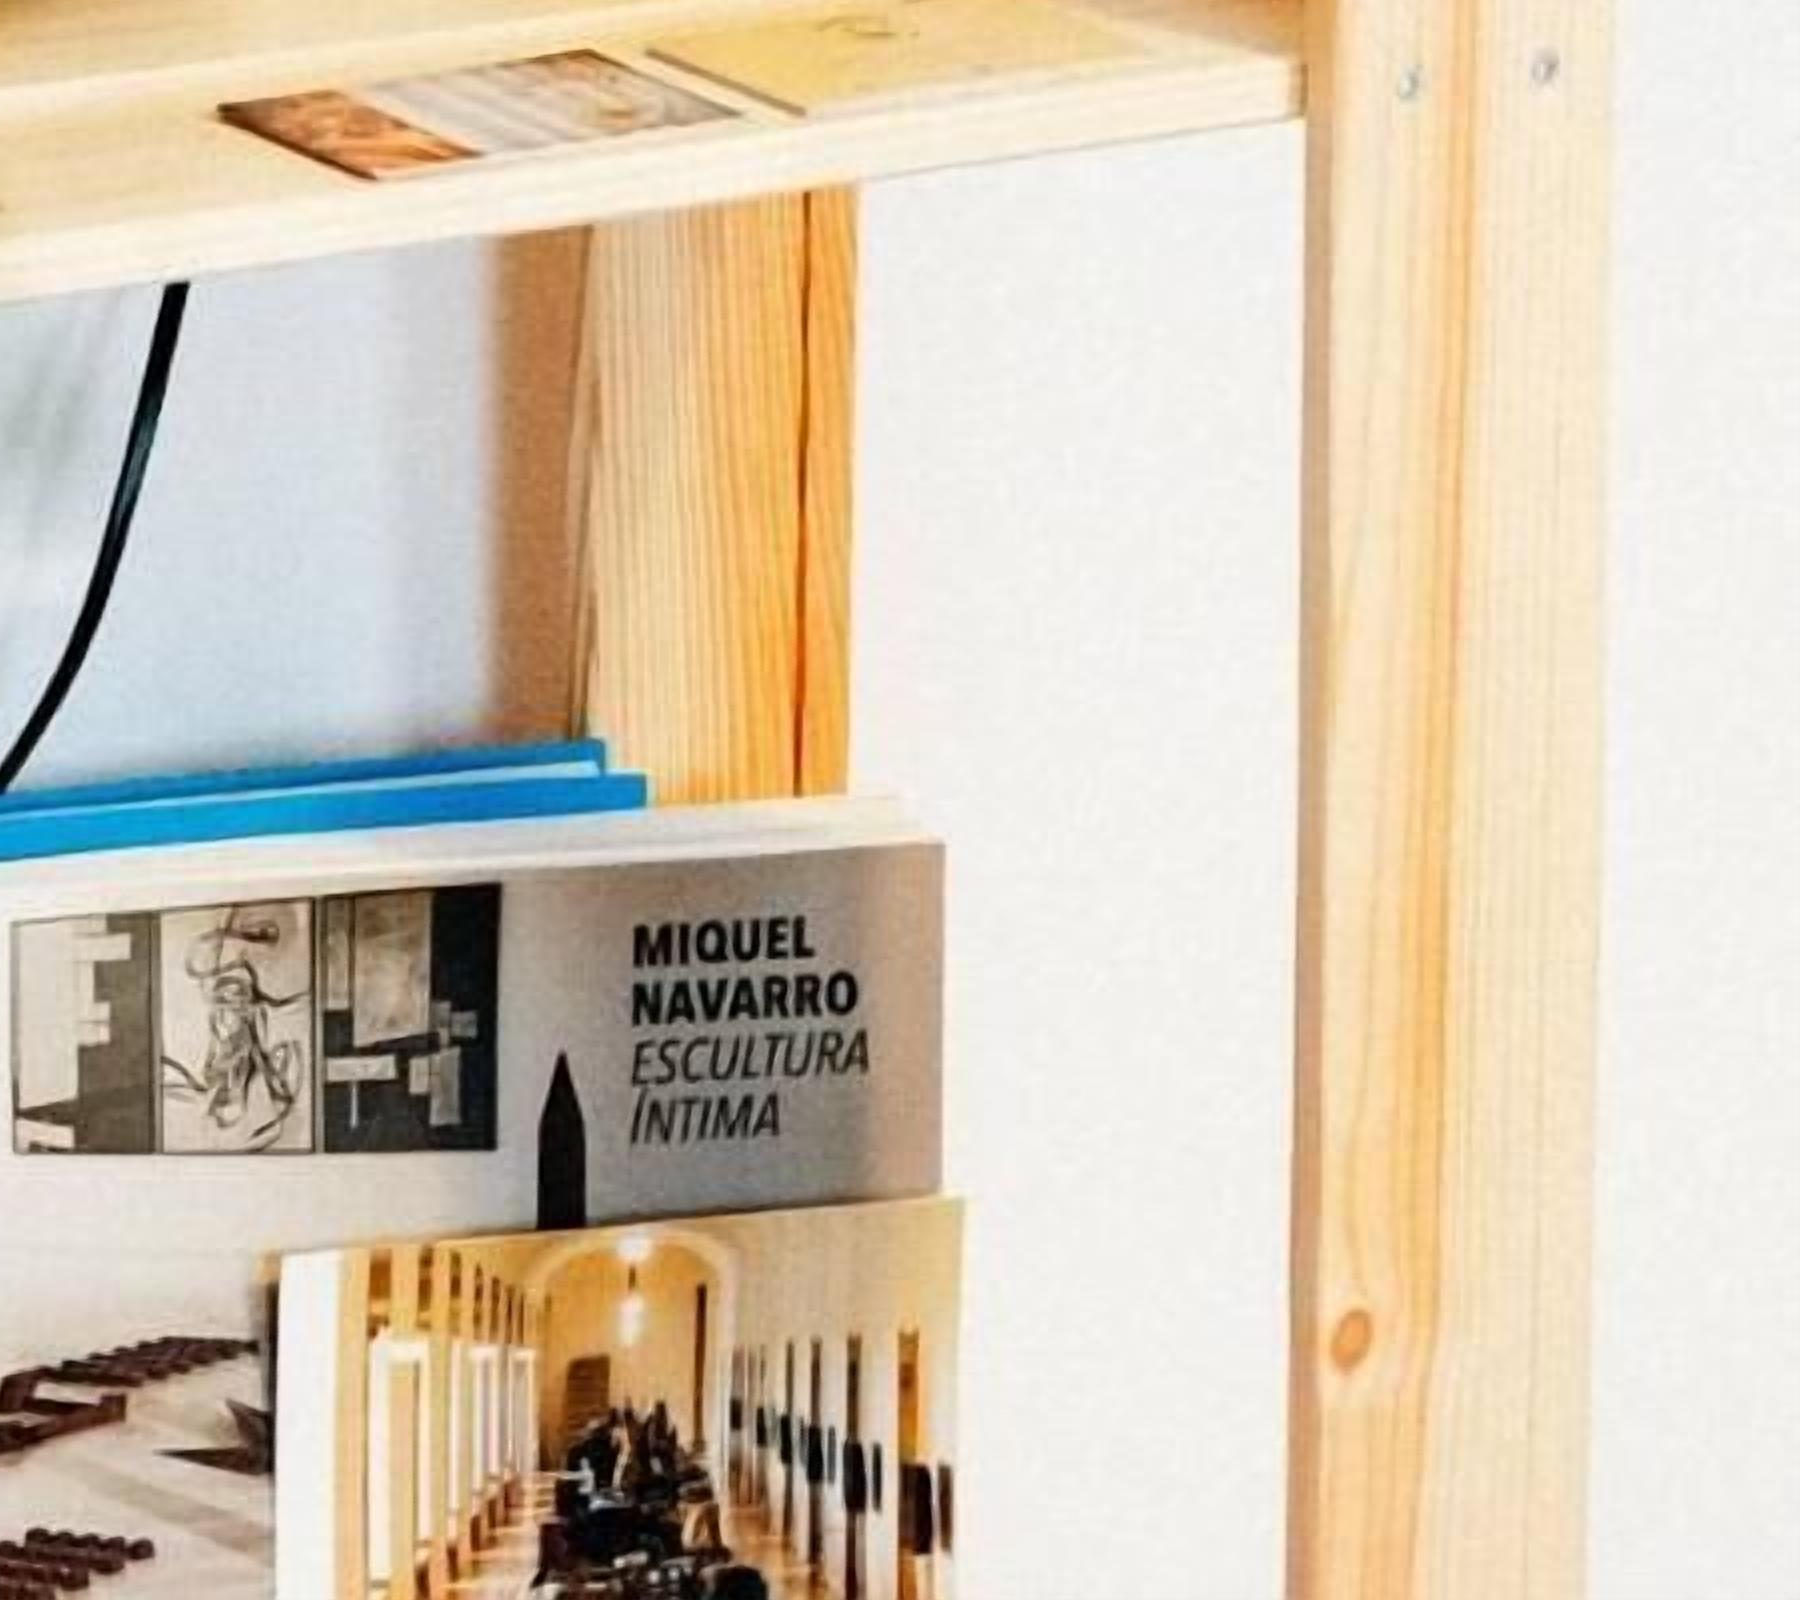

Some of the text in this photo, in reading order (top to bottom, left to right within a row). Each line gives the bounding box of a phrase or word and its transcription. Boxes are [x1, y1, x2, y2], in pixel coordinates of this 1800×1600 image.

[632, 915, 816, 968] MIQUEL
[631, 970, 859, 1027] NAVARRO
[630, 1028, 870, 1087] ESCULTURA
[630, 1086, 781, 1145] ÍNTIMA
